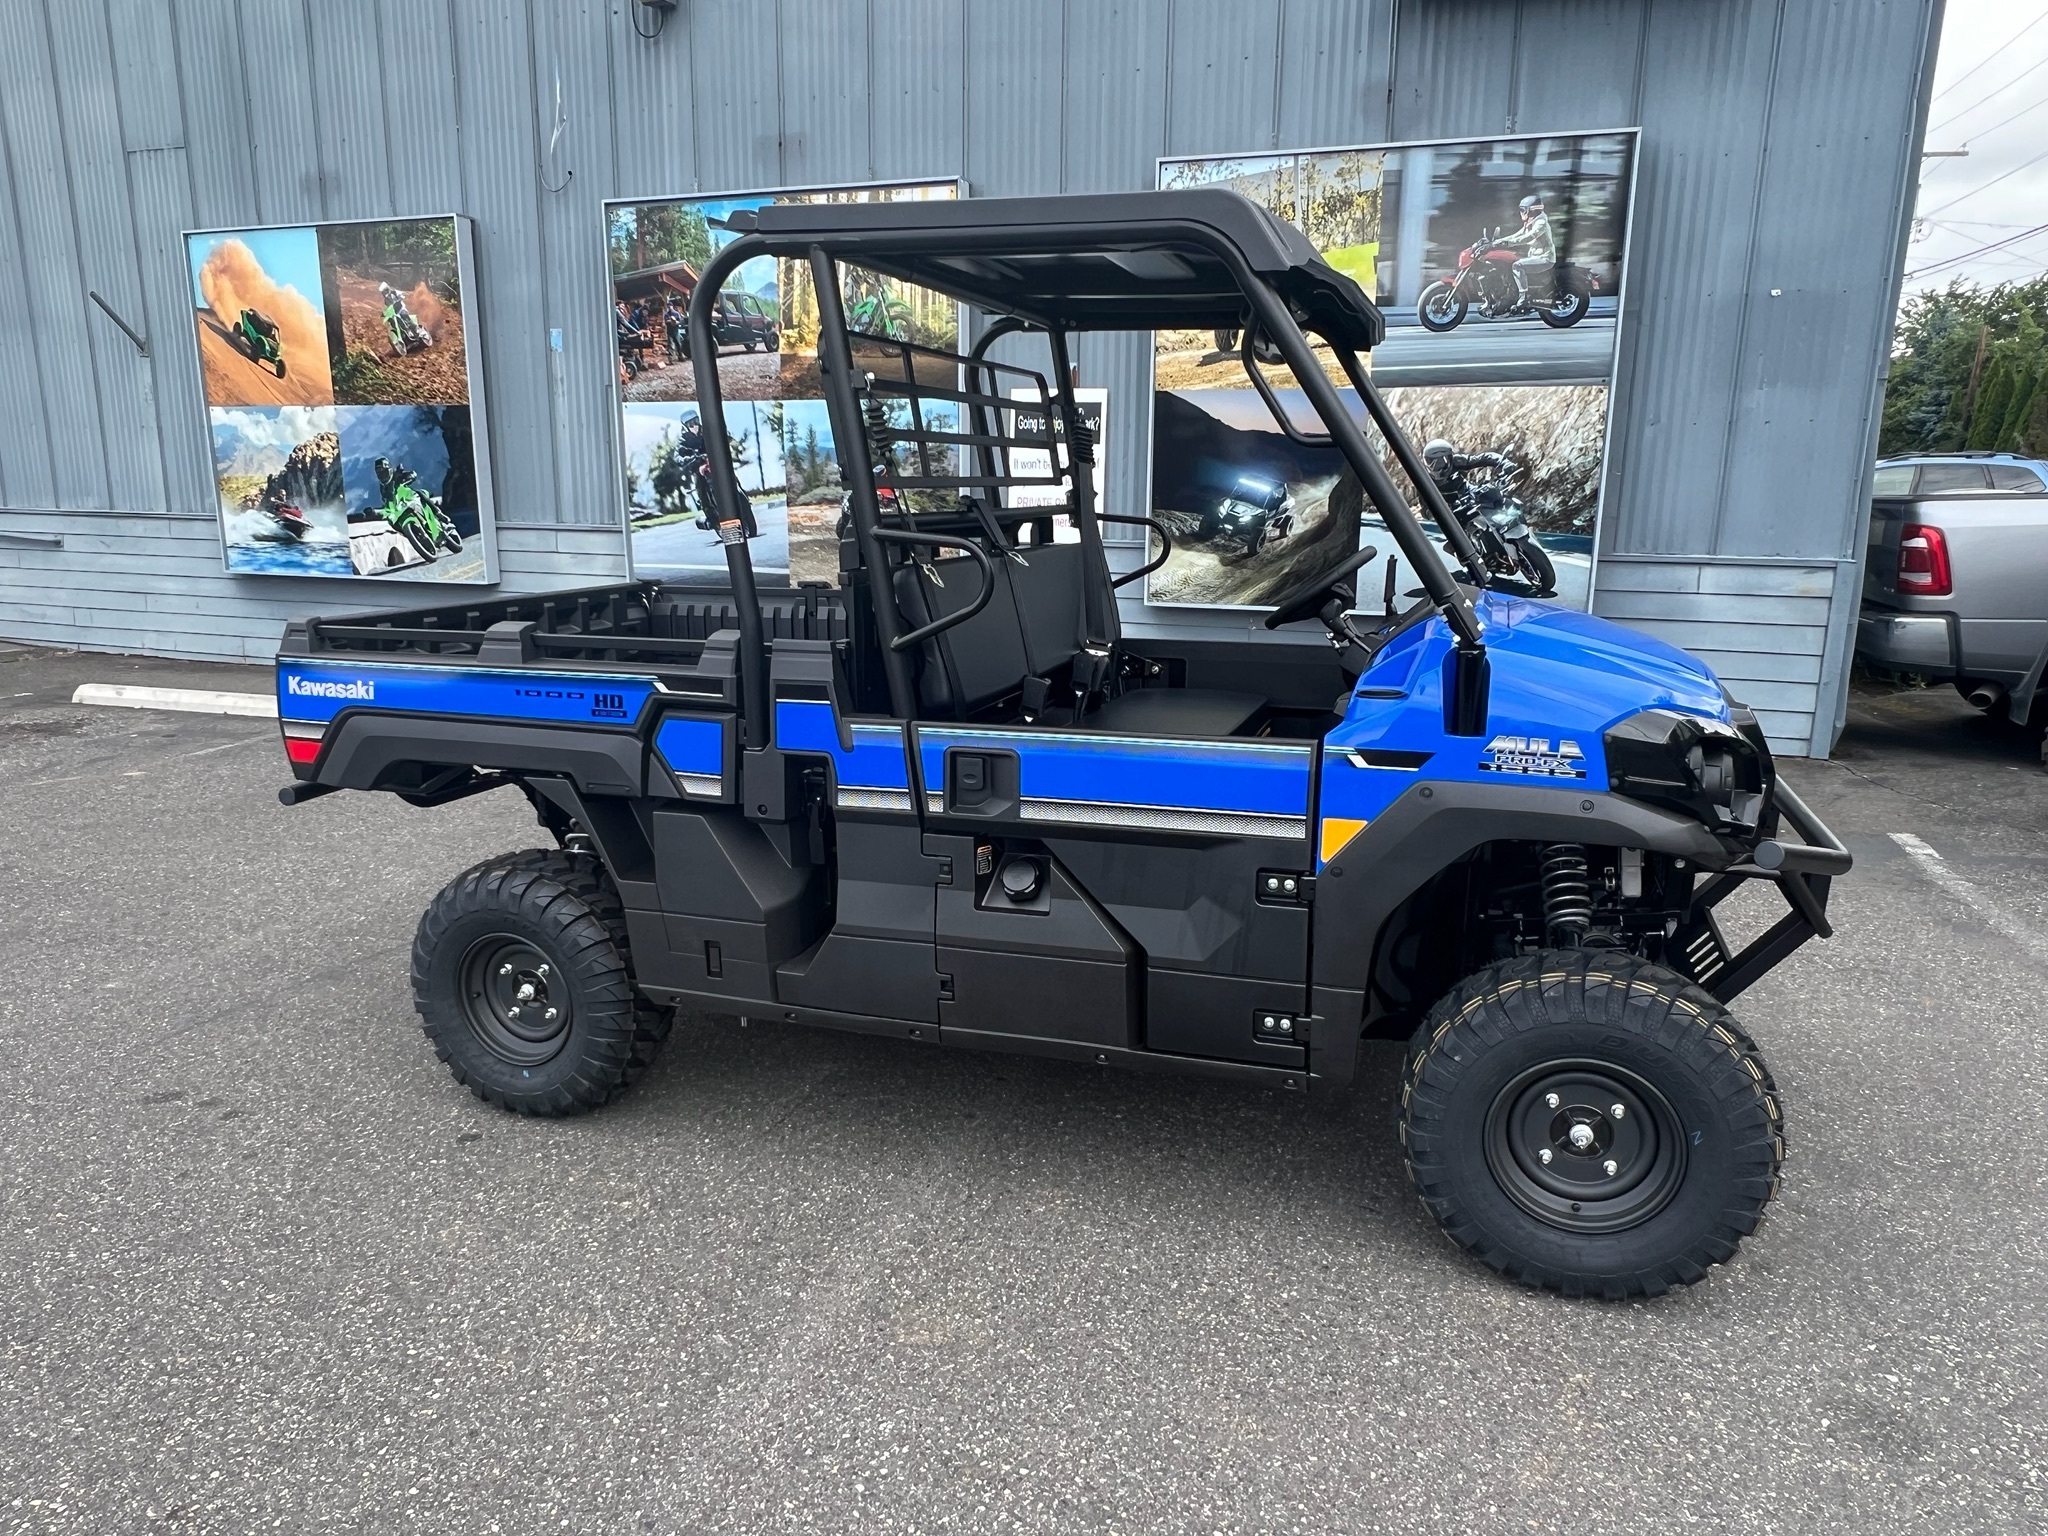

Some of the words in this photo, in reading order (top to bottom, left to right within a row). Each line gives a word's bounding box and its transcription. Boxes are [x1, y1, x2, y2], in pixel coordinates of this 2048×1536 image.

[1017, 415, 1037, 433] Going
[1039, 416, 1046, 430] to
[1020, 457, 1041, 470] won't
[287, 675, 375, 700] Kawasaki
[514, 688, 585, 699] 1000
[594, 693, 624, 709] HD
[1482, 735, 1586, 761] MULE
[1489, 763, 1577, 778] 1000
